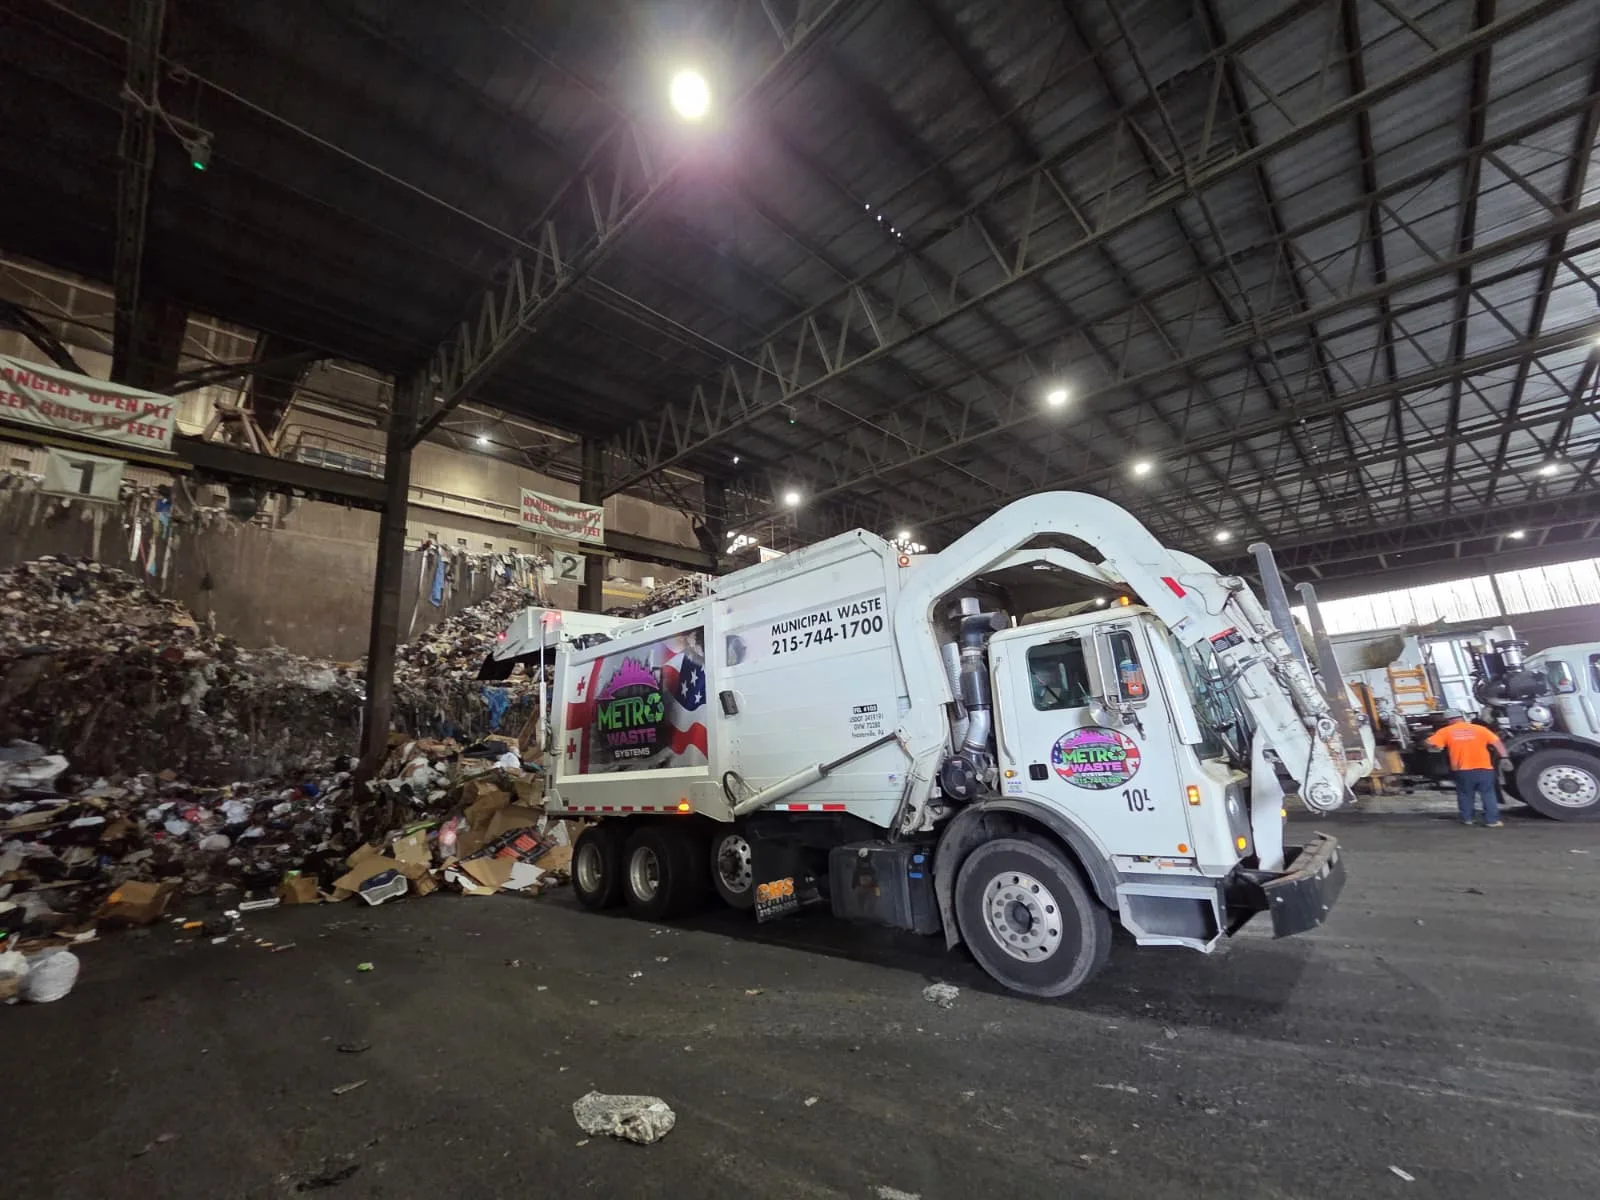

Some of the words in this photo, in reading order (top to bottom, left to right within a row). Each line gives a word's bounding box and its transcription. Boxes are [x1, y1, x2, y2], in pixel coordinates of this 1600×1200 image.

[88, 391, 138, 412] OPEN
[143, 401, 172, 420] PIT
[39, 400, 94, 426] BACK
[127, 421, 168, 440] FEET
[70, 460, 95, 494] 1
[523, 511, 545, 524] KEEP
[560, 556, 578, 579] 2
[771, 611, 832, 636] MUNICIPAL
[837, 597, 882, 619] WASTE
[771, 615, 883, 655] 215-744-1700
[607, 728, 657, 745] WASTE
[614, 747, 650, 758] SYSTEMS
[1070, 762, 1122, 773] WASTE
